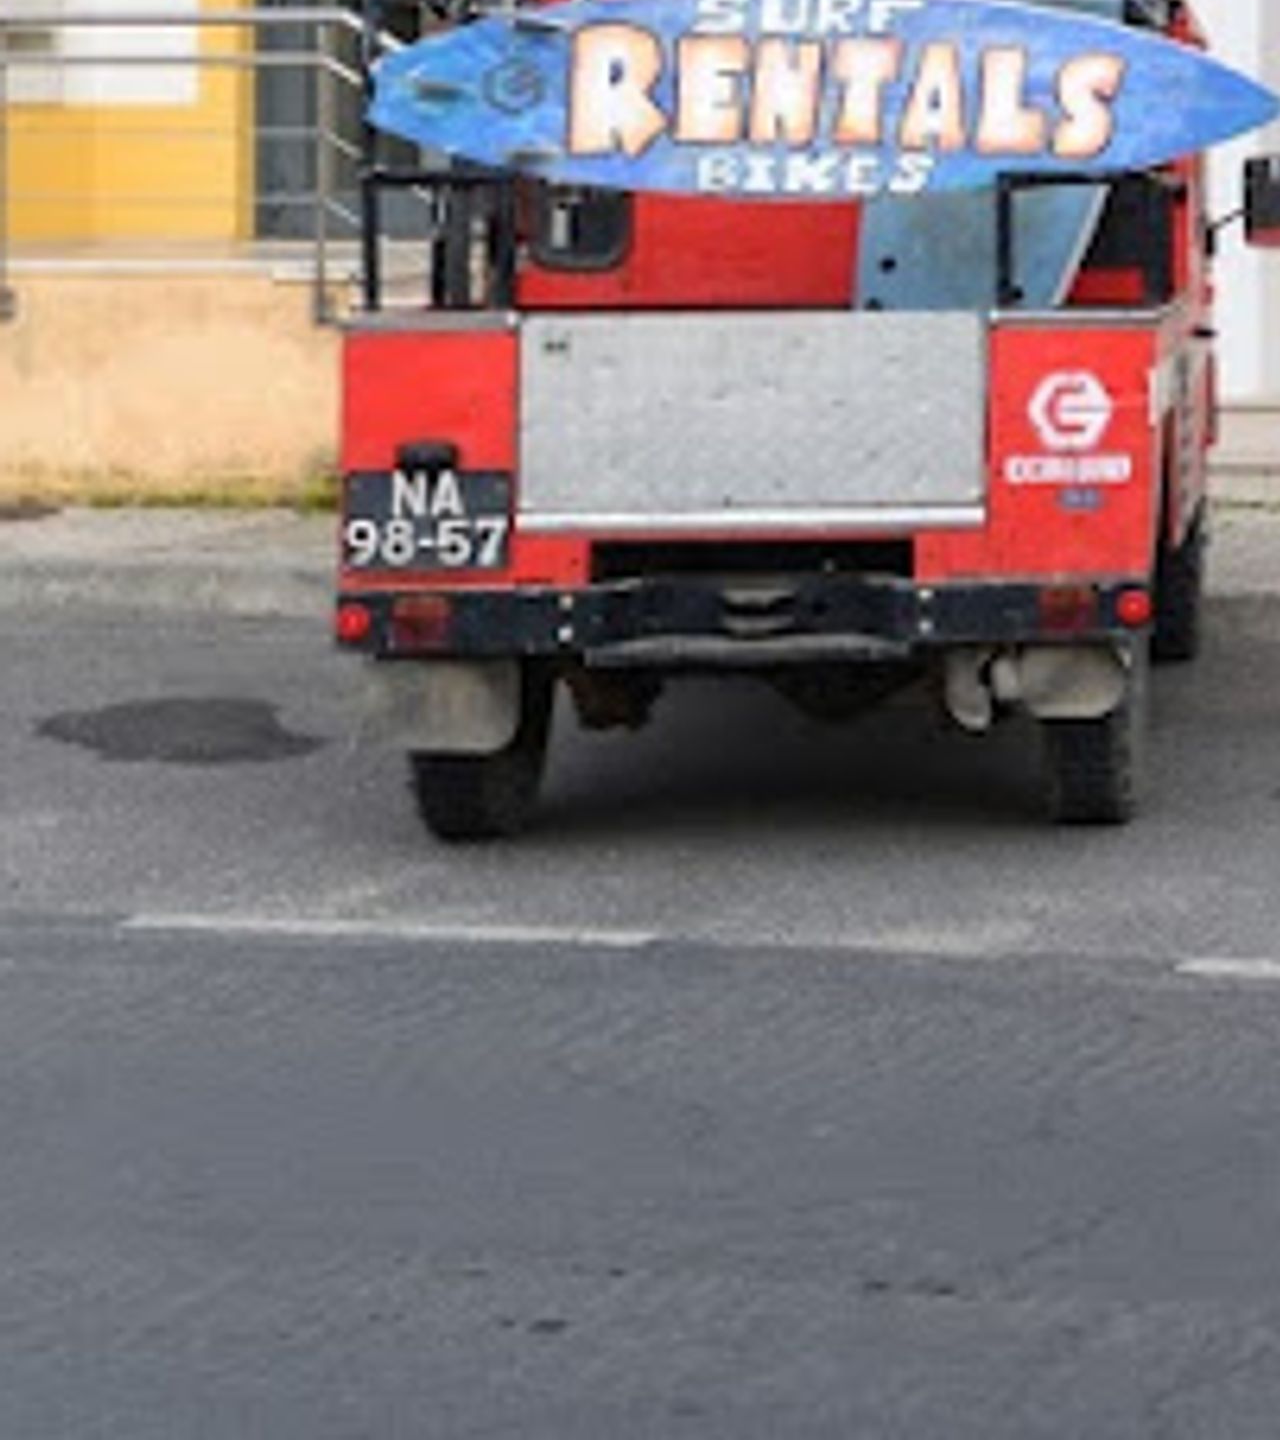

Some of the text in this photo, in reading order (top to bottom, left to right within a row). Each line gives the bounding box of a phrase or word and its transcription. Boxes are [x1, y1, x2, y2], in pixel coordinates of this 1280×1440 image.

[568, 18, 1126, 158] RENTALS
[700, 152, 936, 194] BIKES
[392, 469, 465, 516] NA
[347, 516, 508, 568] 98-57
